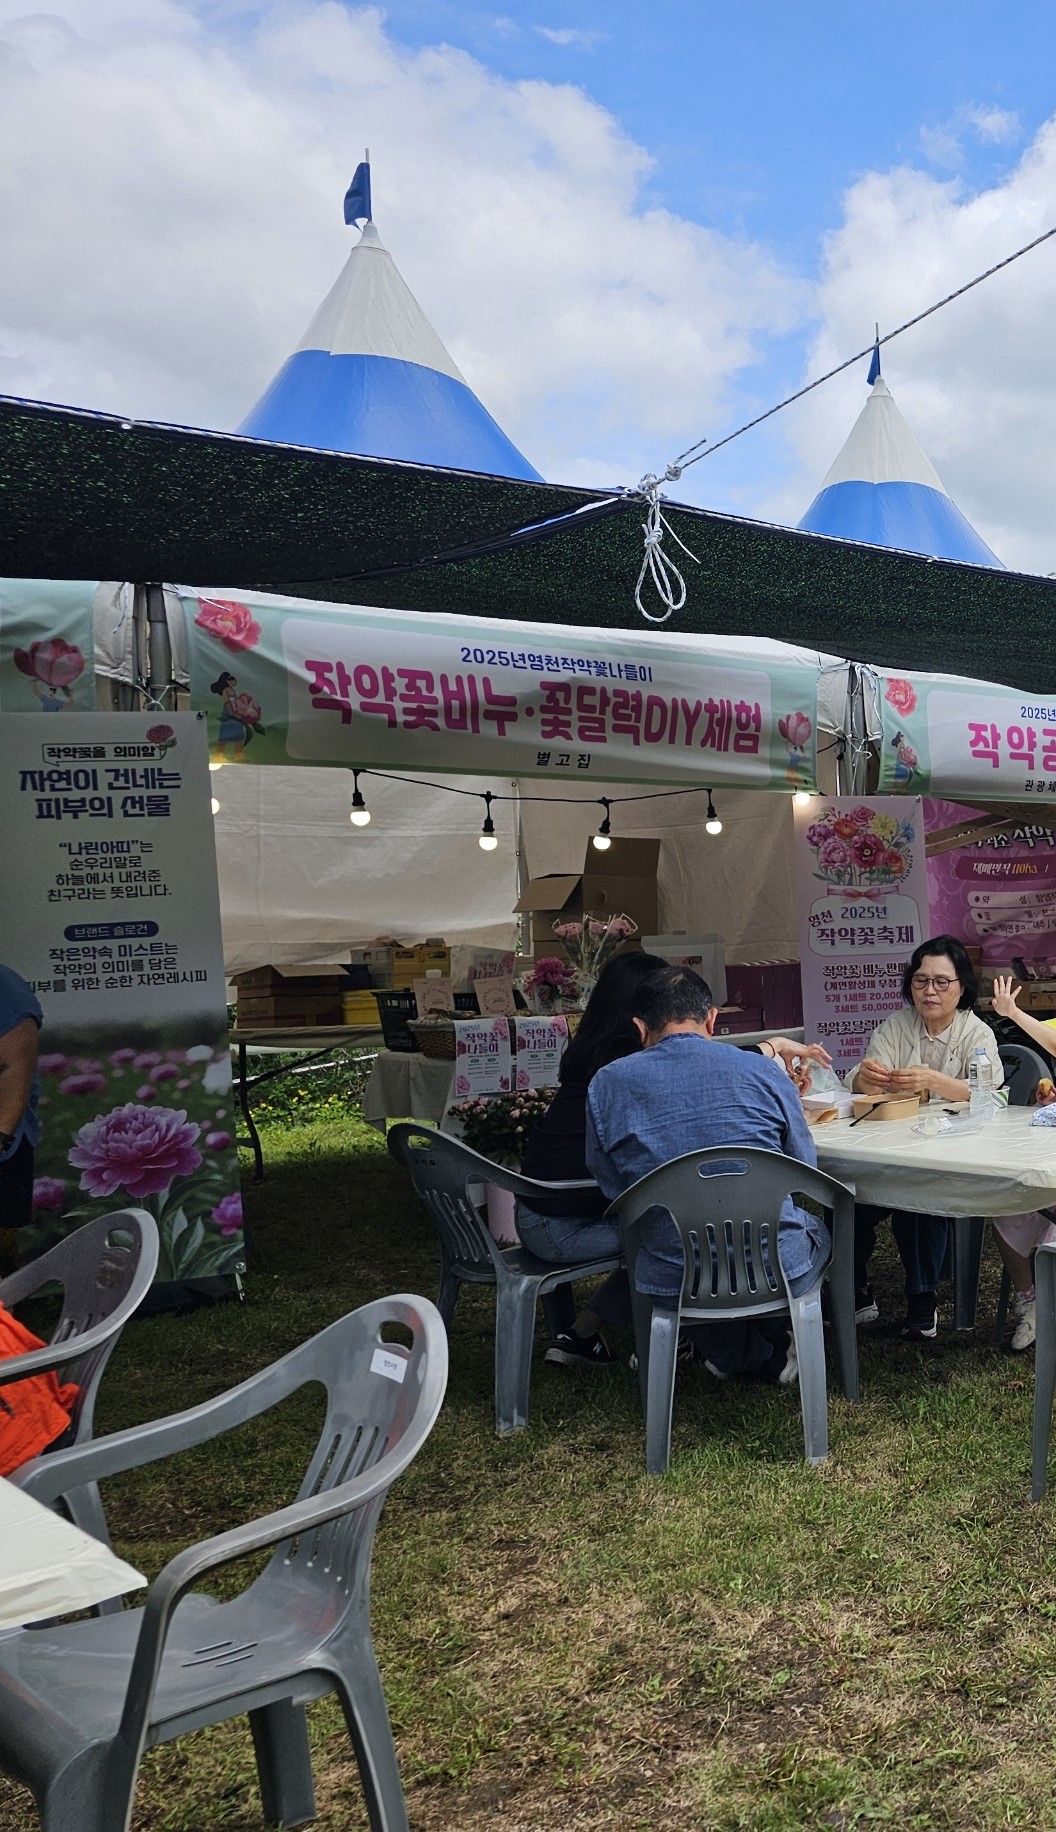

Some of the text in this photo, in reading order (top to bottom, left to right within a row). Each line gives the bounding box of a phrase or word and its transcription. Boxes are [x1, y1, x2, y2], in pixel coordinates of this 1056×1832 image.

[461, 647, 653, 682] 2025년영천작약꽃나들이
[47, 746, 107, 759] 작약꽃을
[19, 767, 182, 792] 자연이 건네는
[35, 794, 171, 820] 피부의 선물
[69, 856, 142, 871] 순우리말로
[55, 869, 162, 887] 하늘에서 내려준
[47, 884, 173, 902] 친구라는 뜻입니다.
[808, 905, 888, 928] 영천 2025년
[74, 924, 148, 938] 브랜드 슬로건
[816, 925, 915, 947] 작약꽃축제
[49, 942, 179, 962] 작은약속 미스트는
[53, 956, 177, 977] 작약의 의미를 담은
[822, 964, 861, 980] 작약꽃
[71, 975, 101, 991] 위한
[104, 974, 133, 990] 순한
[137, 969, 208, 987] 자연레시피
[843, 992, 868, 1003] 1세트
[834, 1004, 859, 1014] 3세트
[840, 1036, 864, 1047] 1세트
[836, 1048, 861, 1058] 3세트
